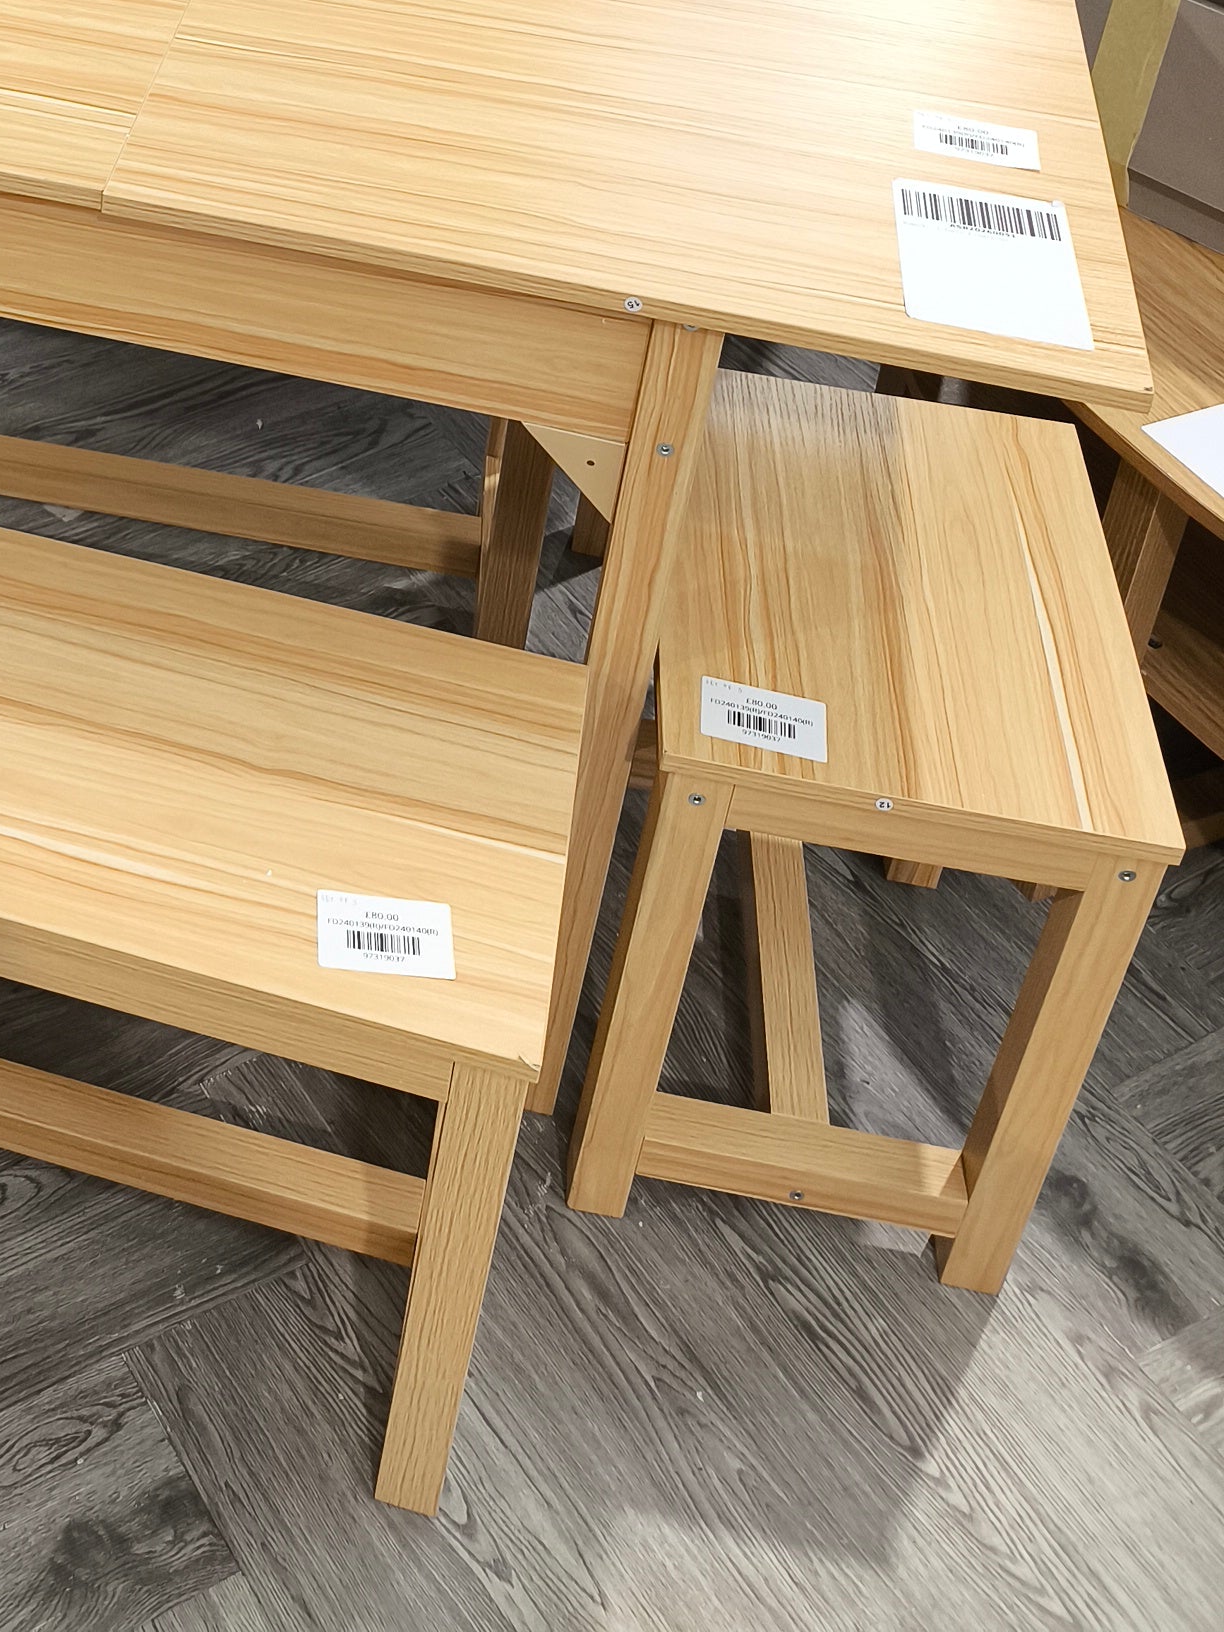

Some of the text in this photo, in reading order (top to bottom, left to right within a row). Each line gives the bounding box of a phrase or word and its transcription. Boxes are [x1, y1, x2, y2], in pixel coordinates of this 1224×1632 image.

[746, 697, 778, 710] £80.00
[742, 728, 781, 743] 97319037
[365, 911, 399, 921] £80.00
[362, 952, 405, 962] 97319037
